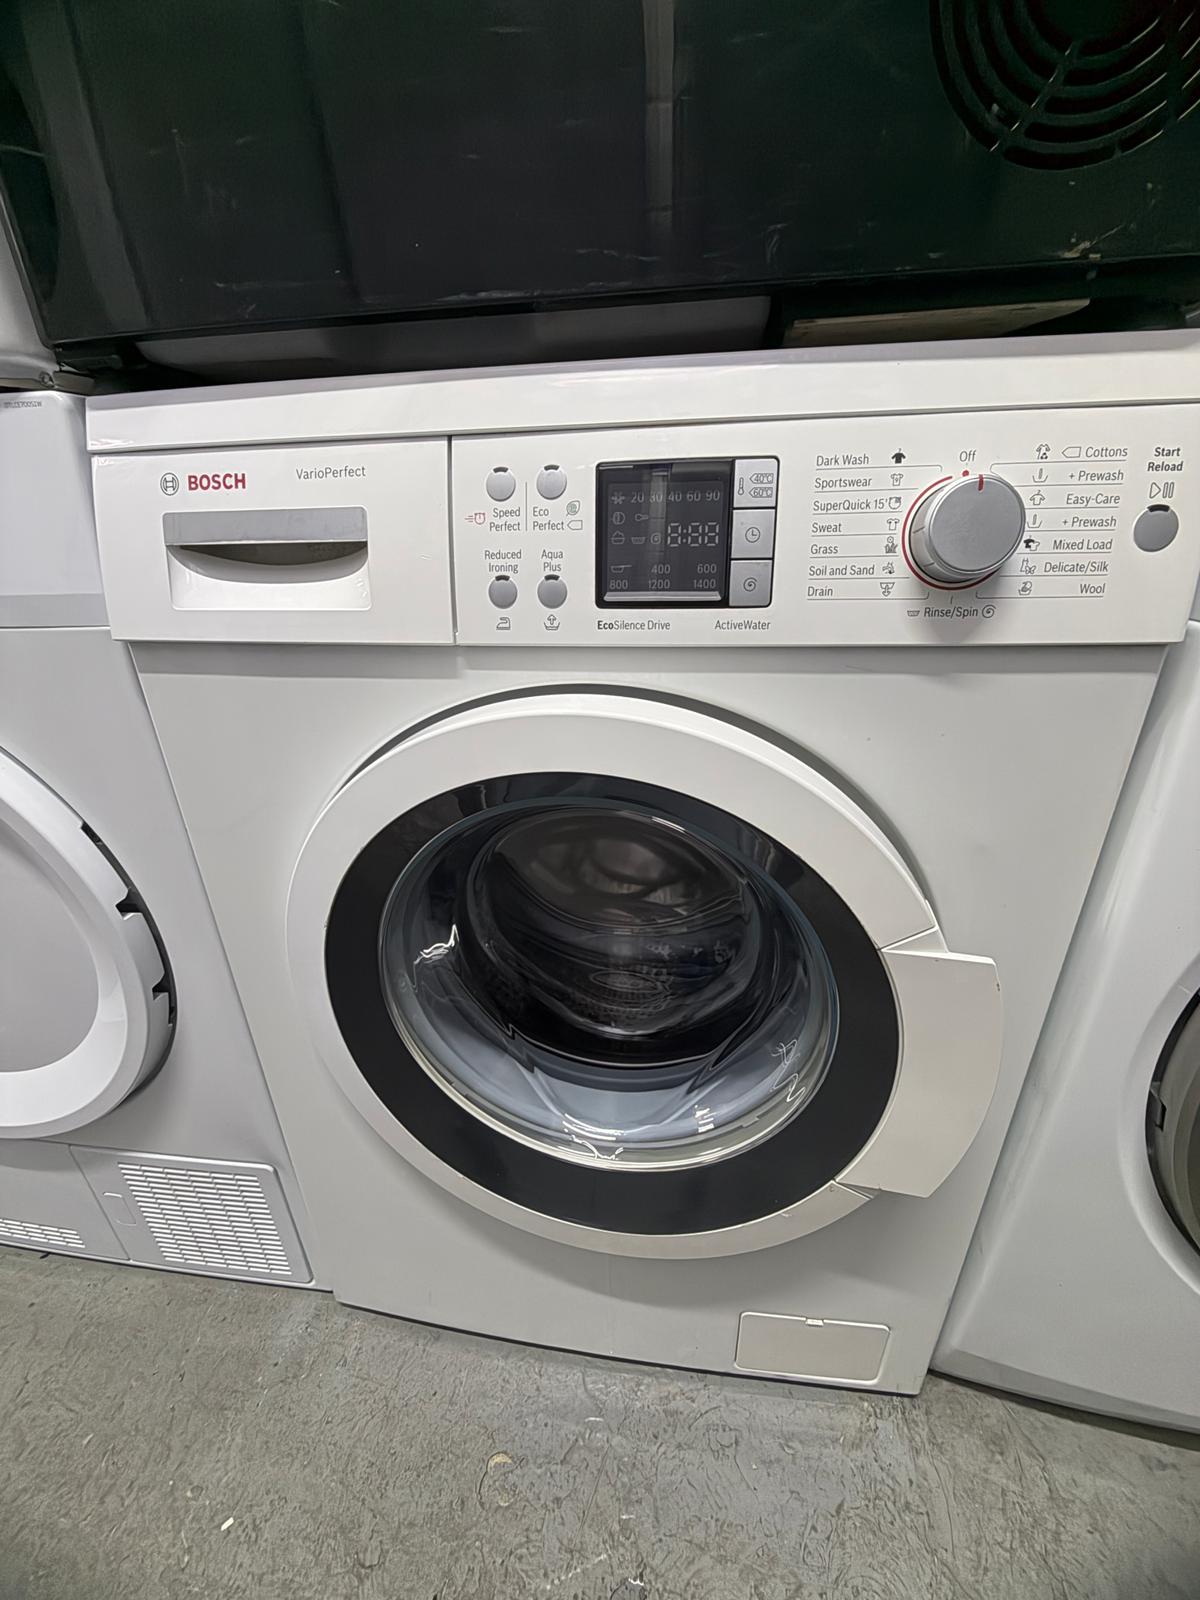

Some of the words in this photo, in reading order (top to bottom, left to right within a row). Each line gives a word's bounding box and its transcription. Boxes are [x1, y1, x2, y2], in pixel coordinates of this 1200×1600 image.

[959, 450, 977, 462] Off
[1085, 446, 1128, 458] Cottons
[1154, 446, 1181, 457] Start
[816, 454, 840, 466] Dark
[842, 453, 870, 466] Wash
[1147, 461, 1184, 472] Reload
[295, 466, 366, 480] VarioPerfect
[1078, 469, 1124, 481] Prewash
[187, 473, 247, 491] BOSCH
[814, 477, 872, 490] Sportswear
[630, 491, 645, 503] 20
[668, 491, 682, 502] 40
[686, 491, 701, 502] 60
[705, 491, 721, 502] 90
[1066, 493, 1121, 507] Easy-Care
[532, 506, 550, 517] Eco
[813, 499, 871, 513] SuperQuick
[492, 507, 521, 519] Speed
[489, 521, 521, 532] Perfect
[532, 521, 565, 531] Perfect
[1071, 515, 1117, 527] Prewash
[811, 522, 842, 533] Sweat
[810, 544, 838, 555] Grass
[1052, 539, 1084, 550] Mixed
[1086, 538, 1113, 550] Load
[484, 549, 522, 560] Reduced
[541, 549, 564, 561] Aqua
[488, 563, 519, 574] Ironing
[543, 562, 562, 572] Plus
[651, 564, 671, 575] 400
[697, 564, 717, 574] 600
[809, 566, 827, 577] Soil
[829, 566, 848, 576] and
[850, 564, 875, 576] Sand
[1044, 561, 1109, 573] Delicate/Silk
[609, 580, 629, 590] 800
[649, 579, 671, 589] 1200
[694, 579, 717, 589] 1400
[1079, 583, 1106, 594] Wool
[807, 586, 833, 597] Drain
[923, 606, 979, 621] Rinse/Spin
[597, 620, 646, 630] EcoSilence
[647, 619, 671, 630] Drive
[714, 619, 771, 630] ActiveWater
